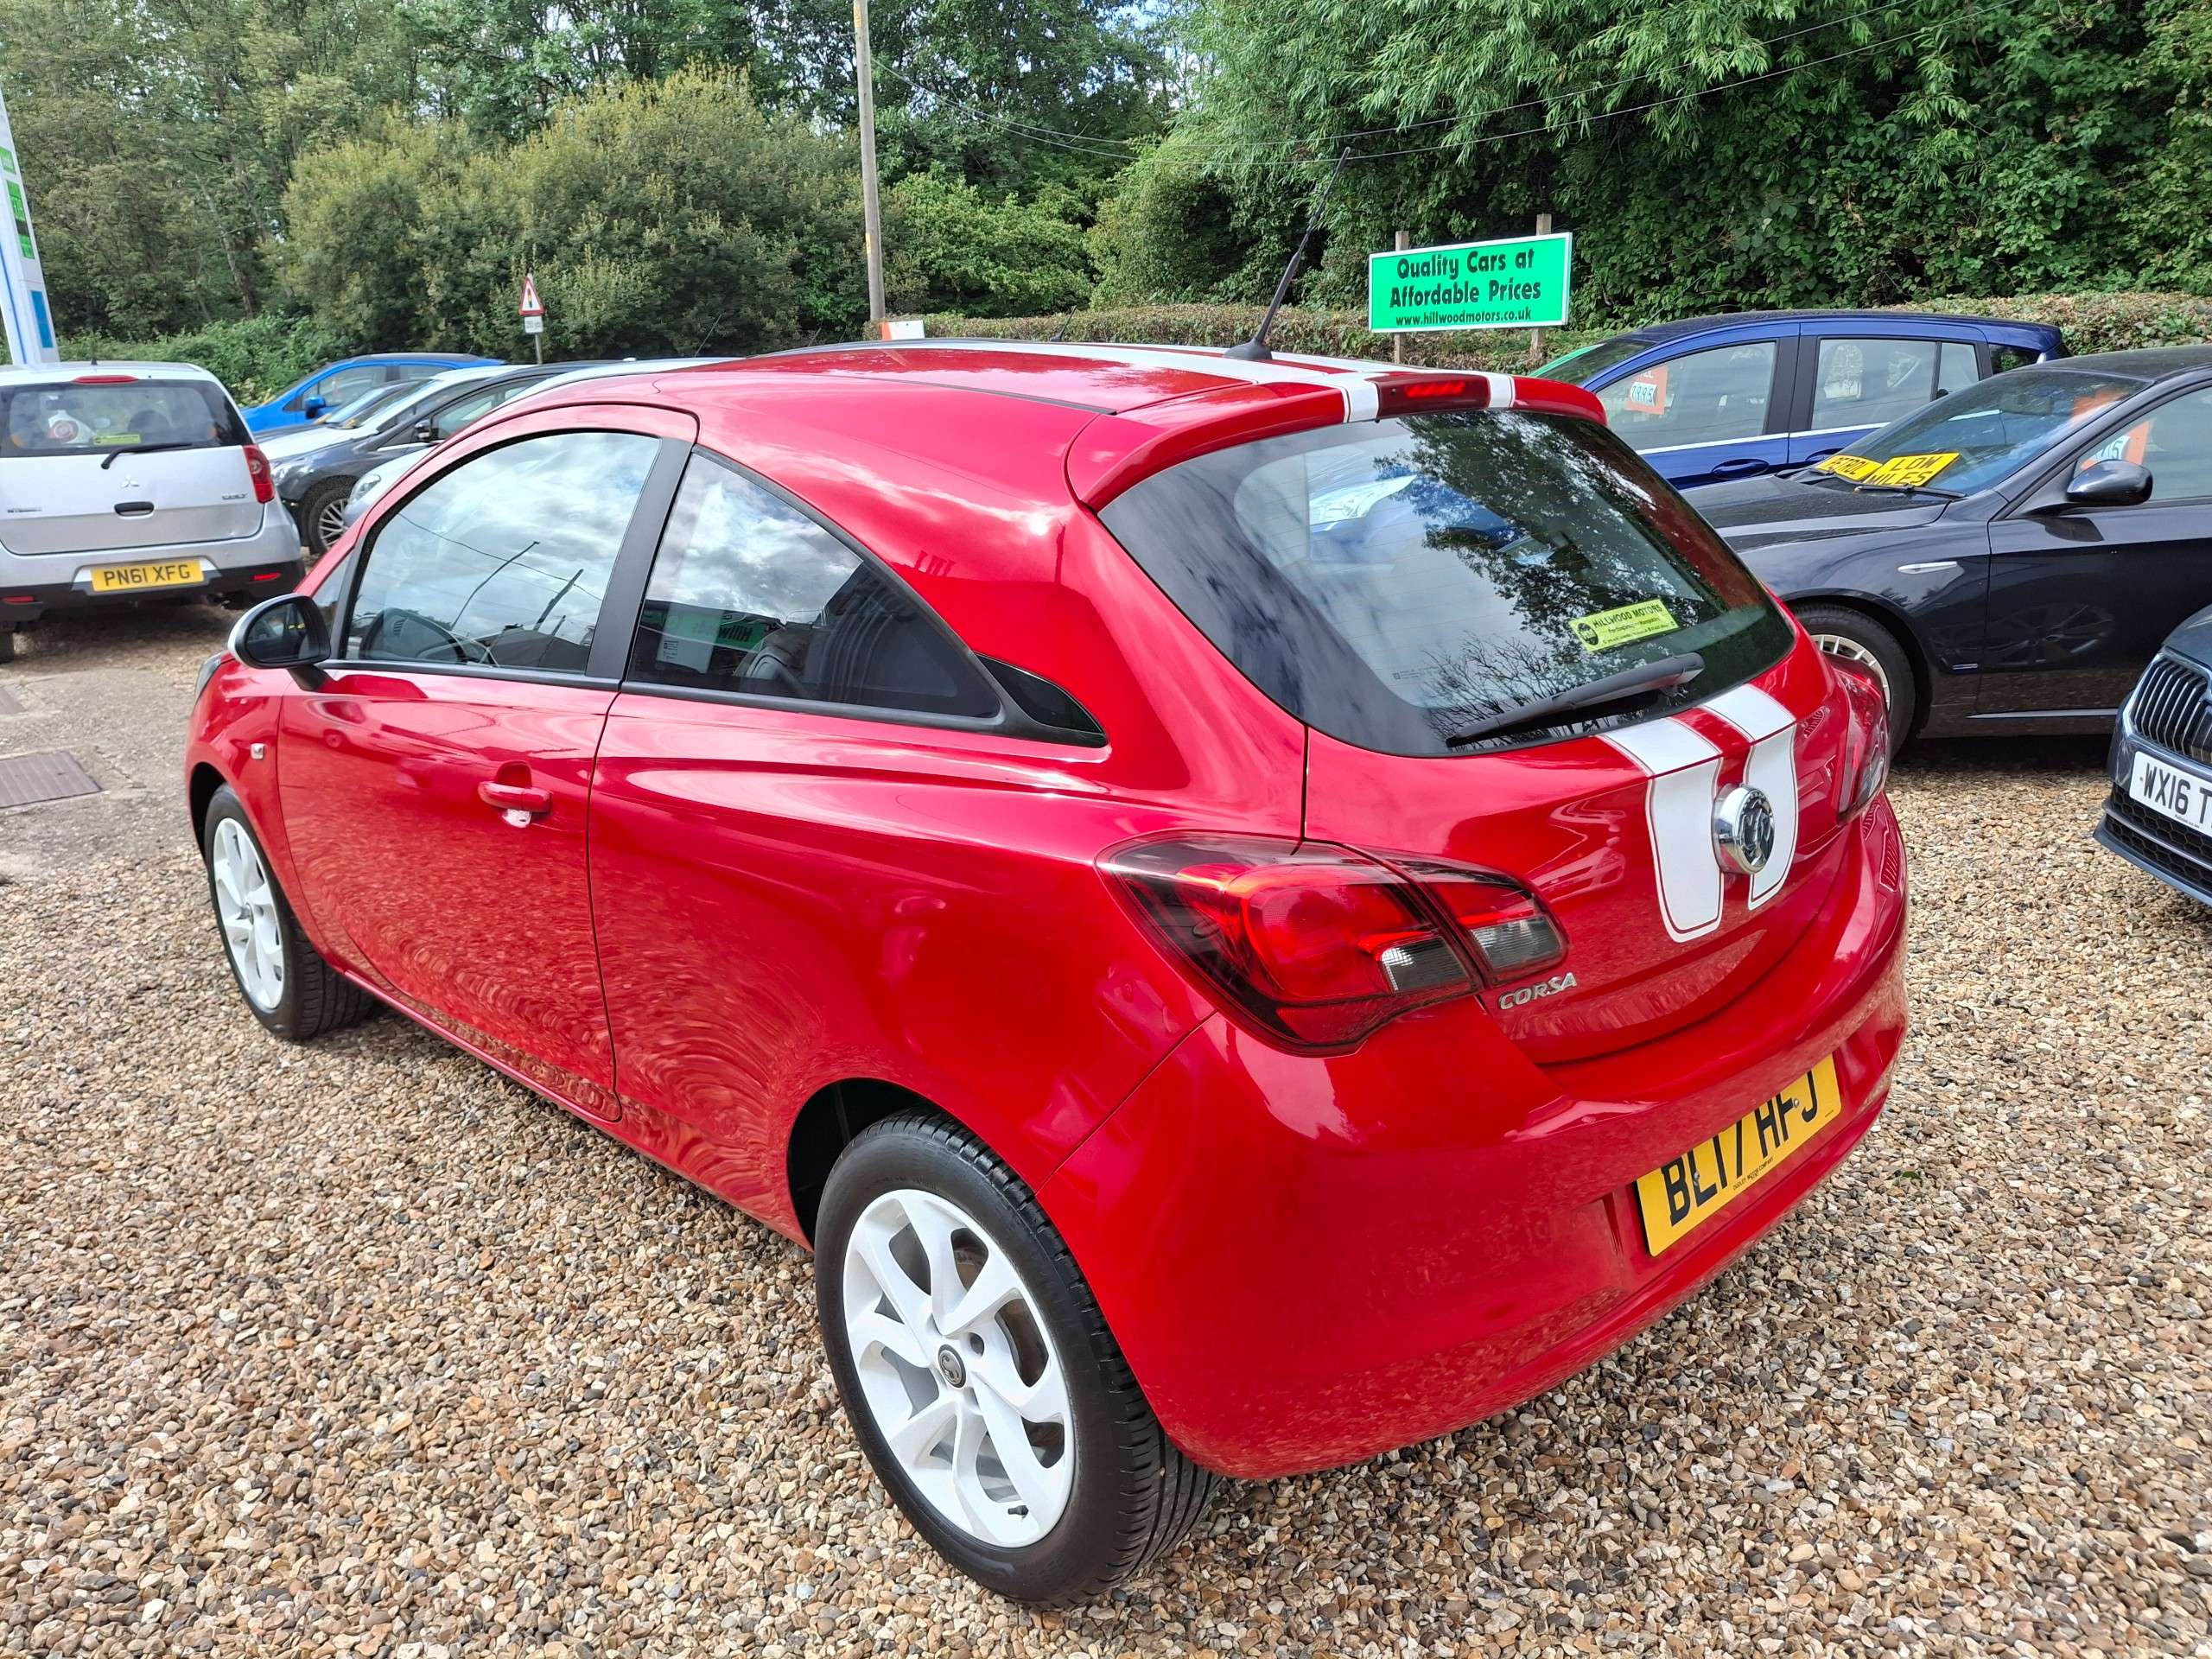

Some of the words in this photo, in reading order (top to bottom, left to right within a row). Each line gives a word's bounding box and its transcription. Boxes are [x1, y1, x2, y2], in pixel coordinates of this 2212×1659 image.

[1396, 253, 1459, 280] Quality
[1466, 251, 1506, 273] Cars
[1515, 248, 1535, 269] at
[1389, 281, 1479, 308] Affordable
[1488, 277, 1541, 302] Prices
[1395, 306, 1531, 326] www.hillwoodmotors.co.uk
[1890, 455, 1943, 472] LOW
[1864, 471, 1933, 485] MILES
[103, 567, 149, 587] PN61
[152, 564, 190, 582] XFG
[1592, 611, 1633, 628] HILLWOOD
[1632, 604, 1663, 618] MOTORS
[2143, 762, 2190, 815] WX16
[1498, 972, 1577, 1010] CORSA
[1754, 1070, 1818, 1159] HFJ
